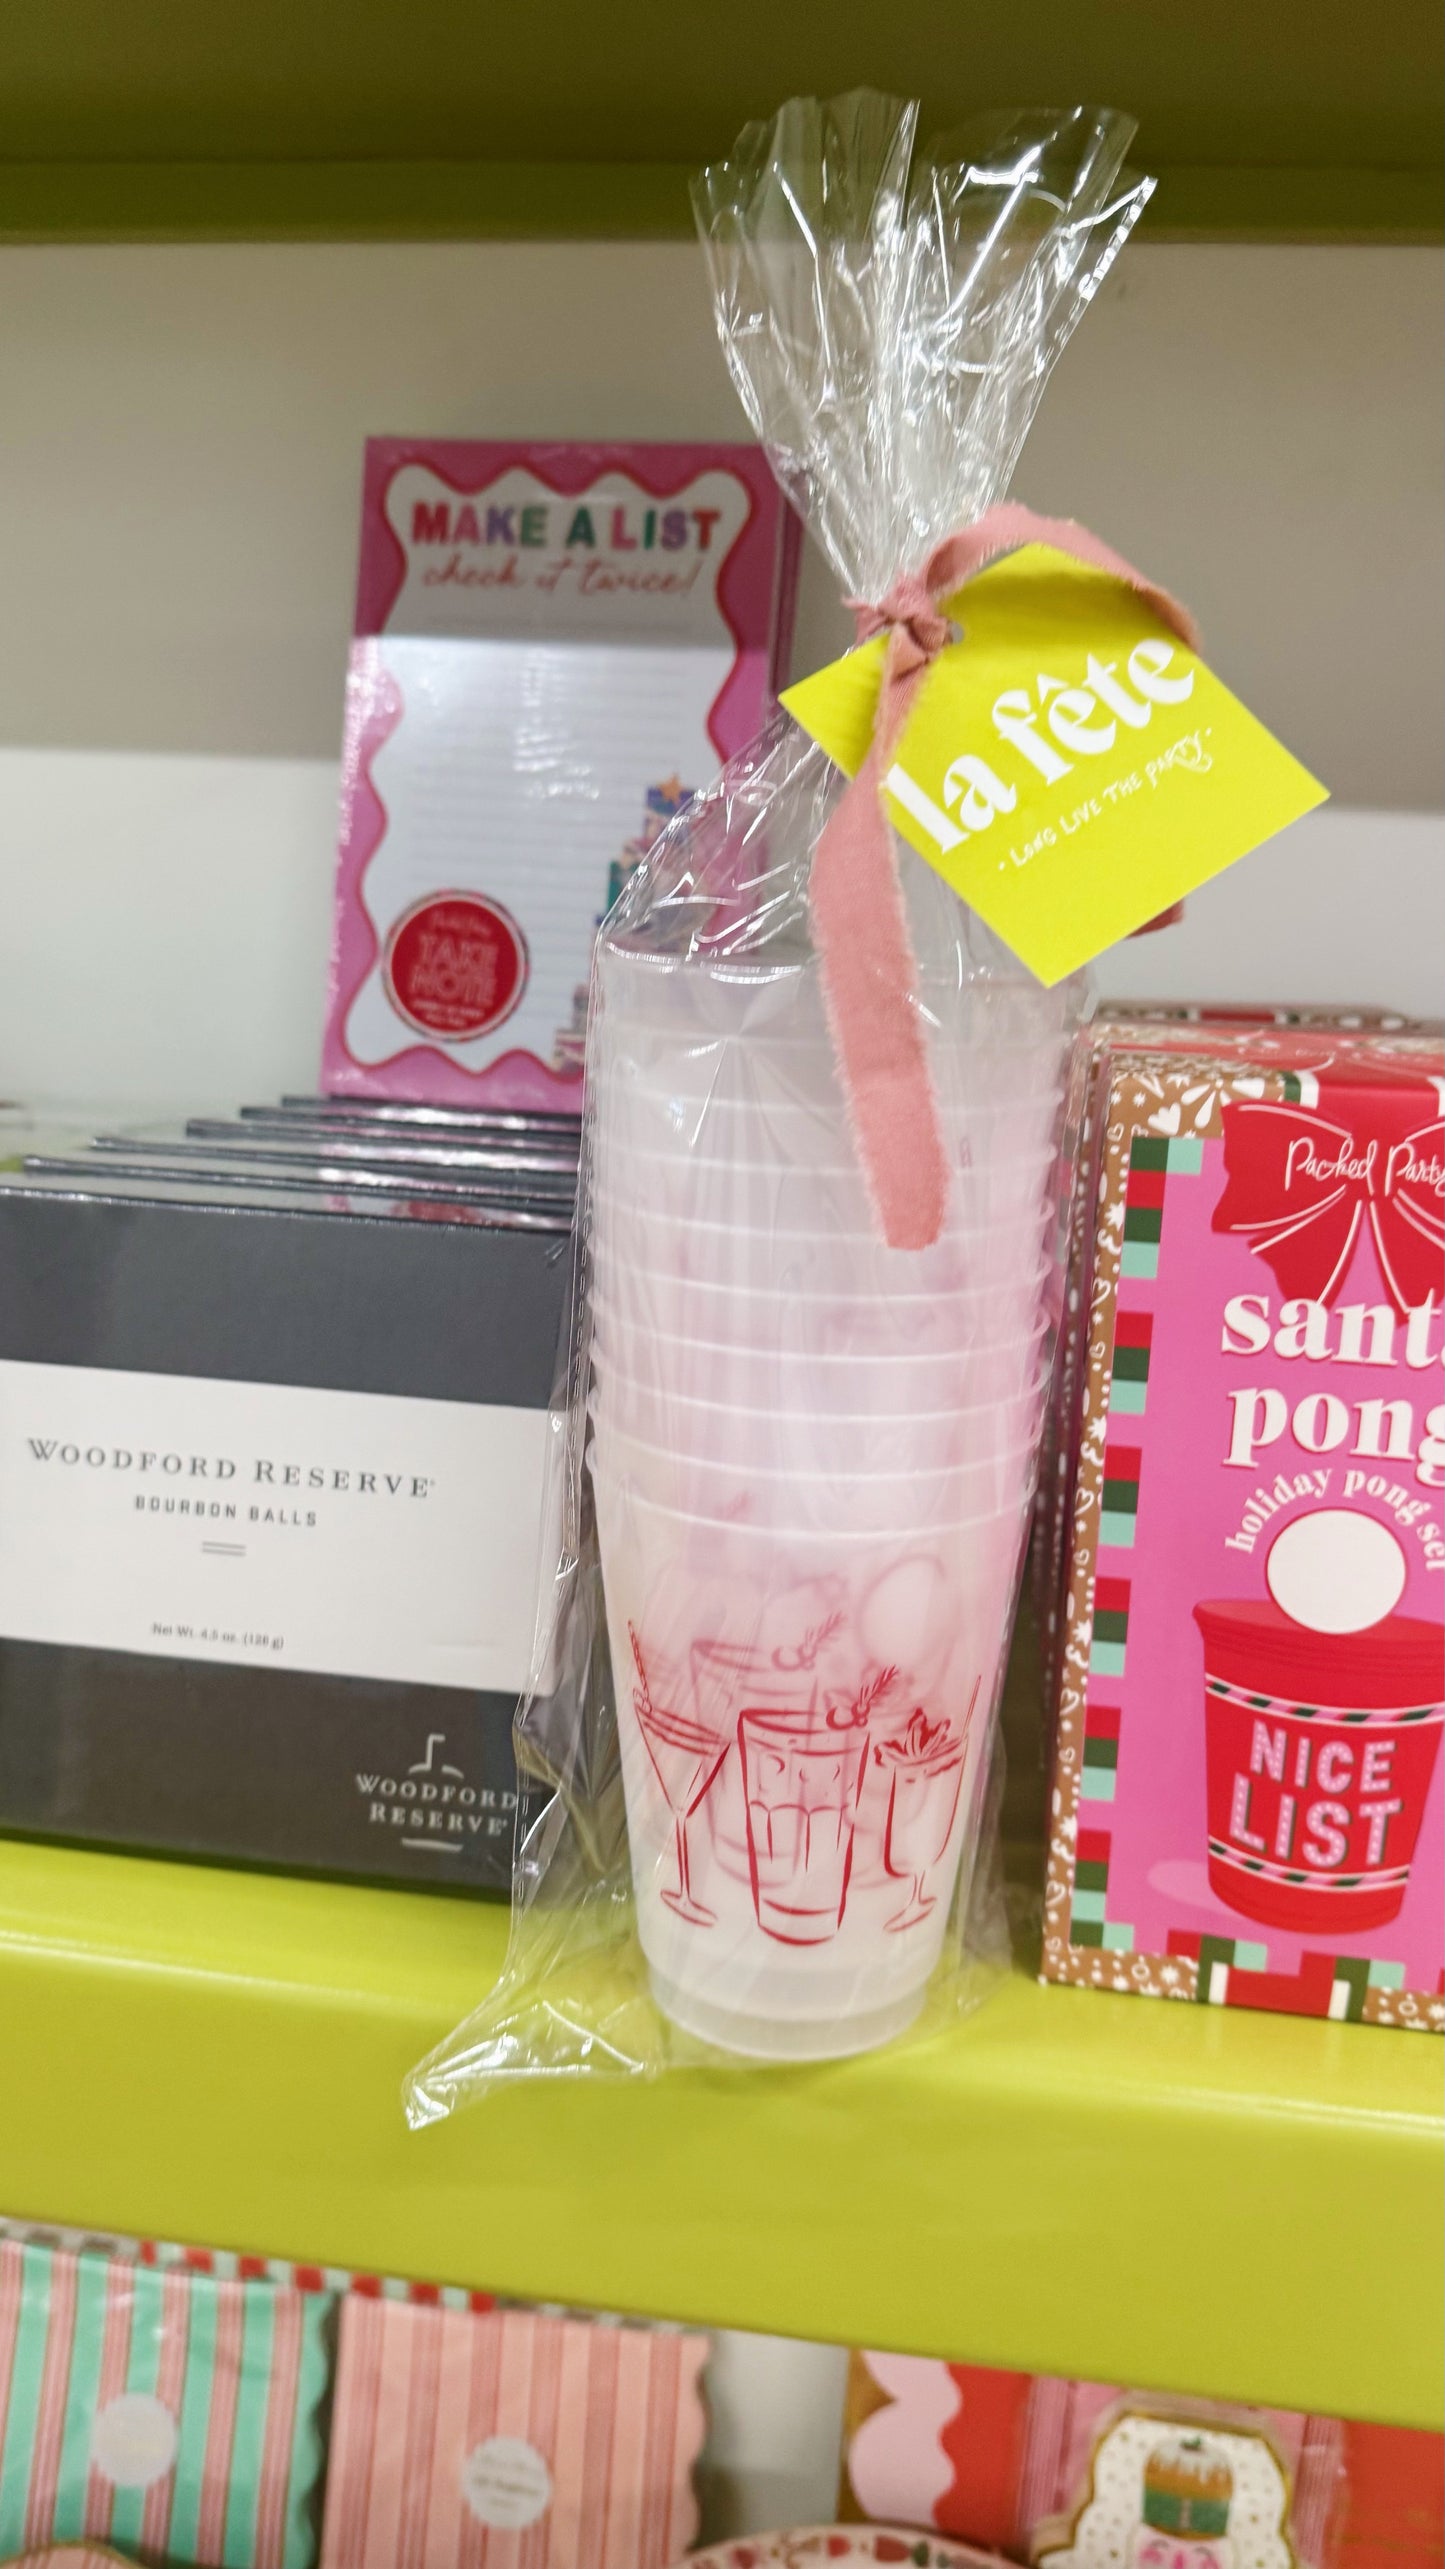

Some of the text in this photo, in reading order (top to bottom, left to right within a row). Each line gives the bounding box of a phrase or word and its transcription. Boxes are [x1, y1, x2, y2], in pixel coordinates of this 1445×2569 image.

[411, 500, 722, 553] MAKE A LIST
[422, 552, 525, 590] check
[535, 555, 575, 594] it
[879, 638, 1195, 856] la fête
[1010, 730, 1213, 868] LONG LIVE THE PARTY
[1221, 1288, 1445, 1369] sant
[27, 1437, 238, 1481] WOODFORD
[134, 1494, 318, 1528] BOURBON BALLS
[1224, 1467, 1333, 1555] holiday
[1343, 1469, 1432, 1527] pong
[355, 1773, 518, 1810] WOODFORD
[1250, 1719, 1397, 1794] NICE
[1229, 1773, 1403, 1869] LIST
